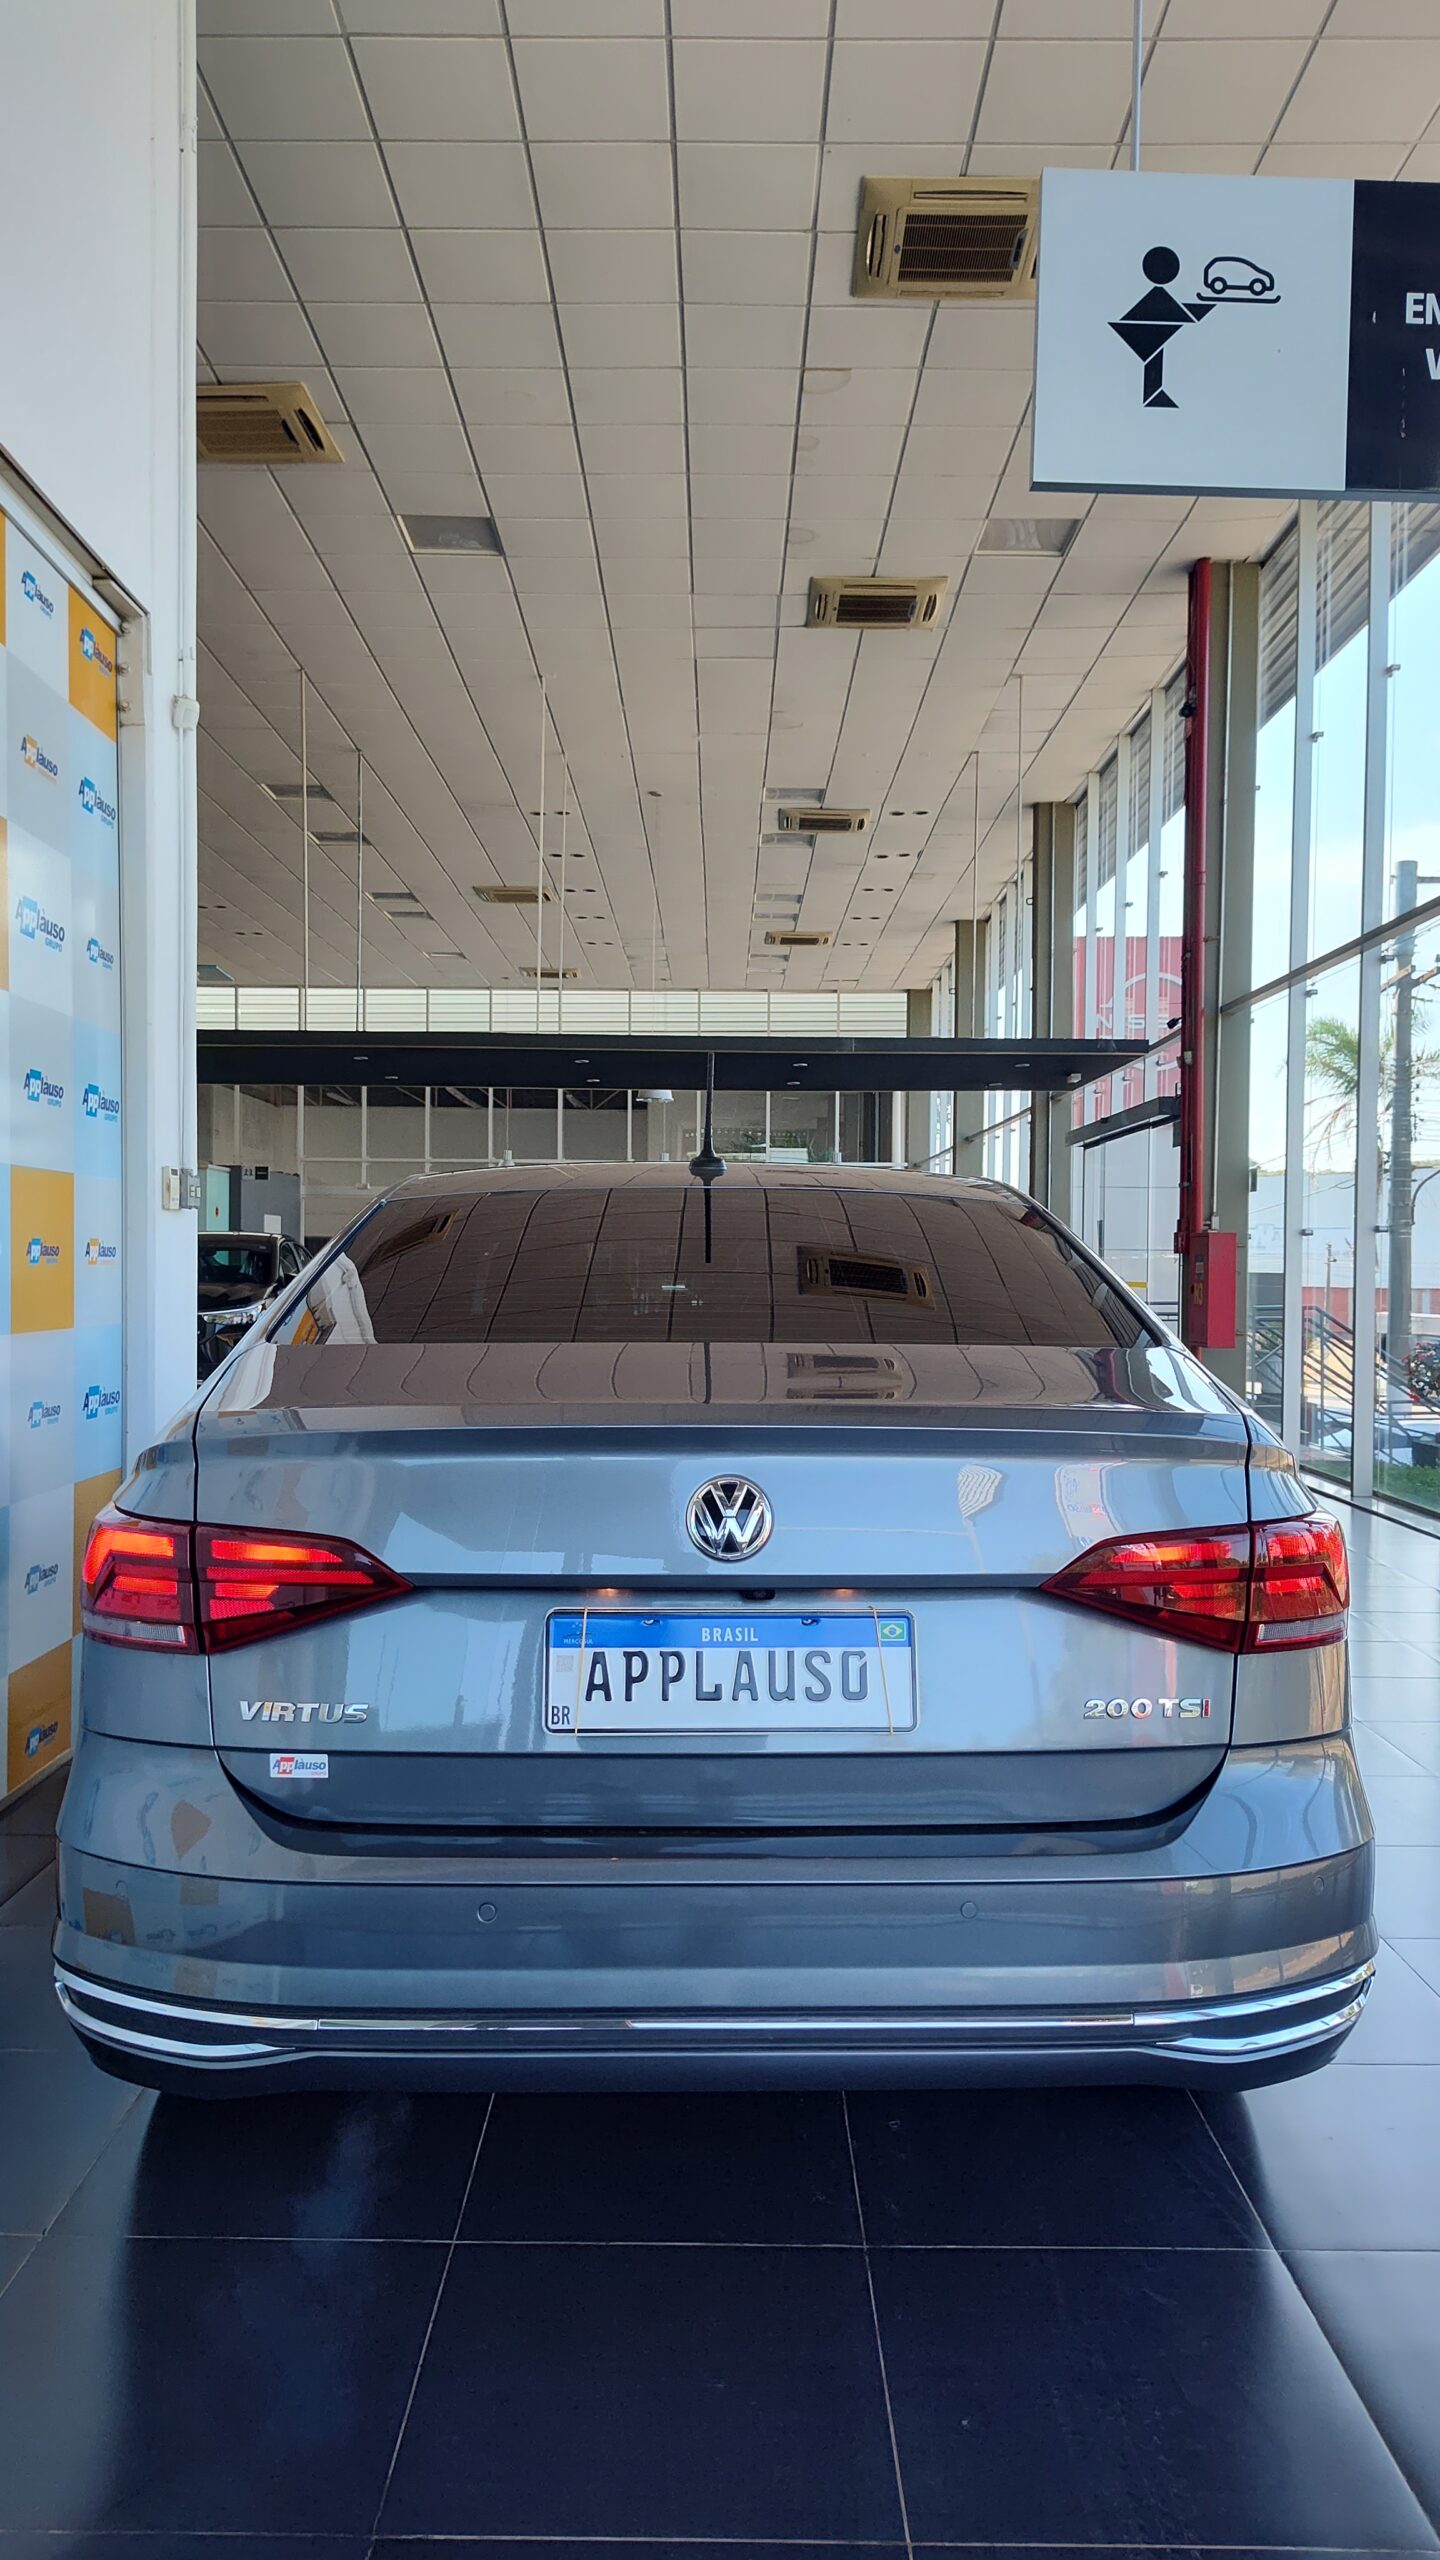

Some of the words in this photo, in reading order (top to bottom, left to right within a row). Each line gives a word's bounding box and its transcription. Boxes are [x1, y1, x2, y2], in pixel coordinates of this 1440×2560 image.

[701, 1627, 759, 1642] BRASIL
[585, 1650, 869, 1702] APPLAUSO
[239, 1700, 369, 1723] VIRTUS
[551, 1705, 571, 1725] BR
[1083, 1698, 1153, 1719] 200
[1158, 1698, 1211, 1718] TSI
